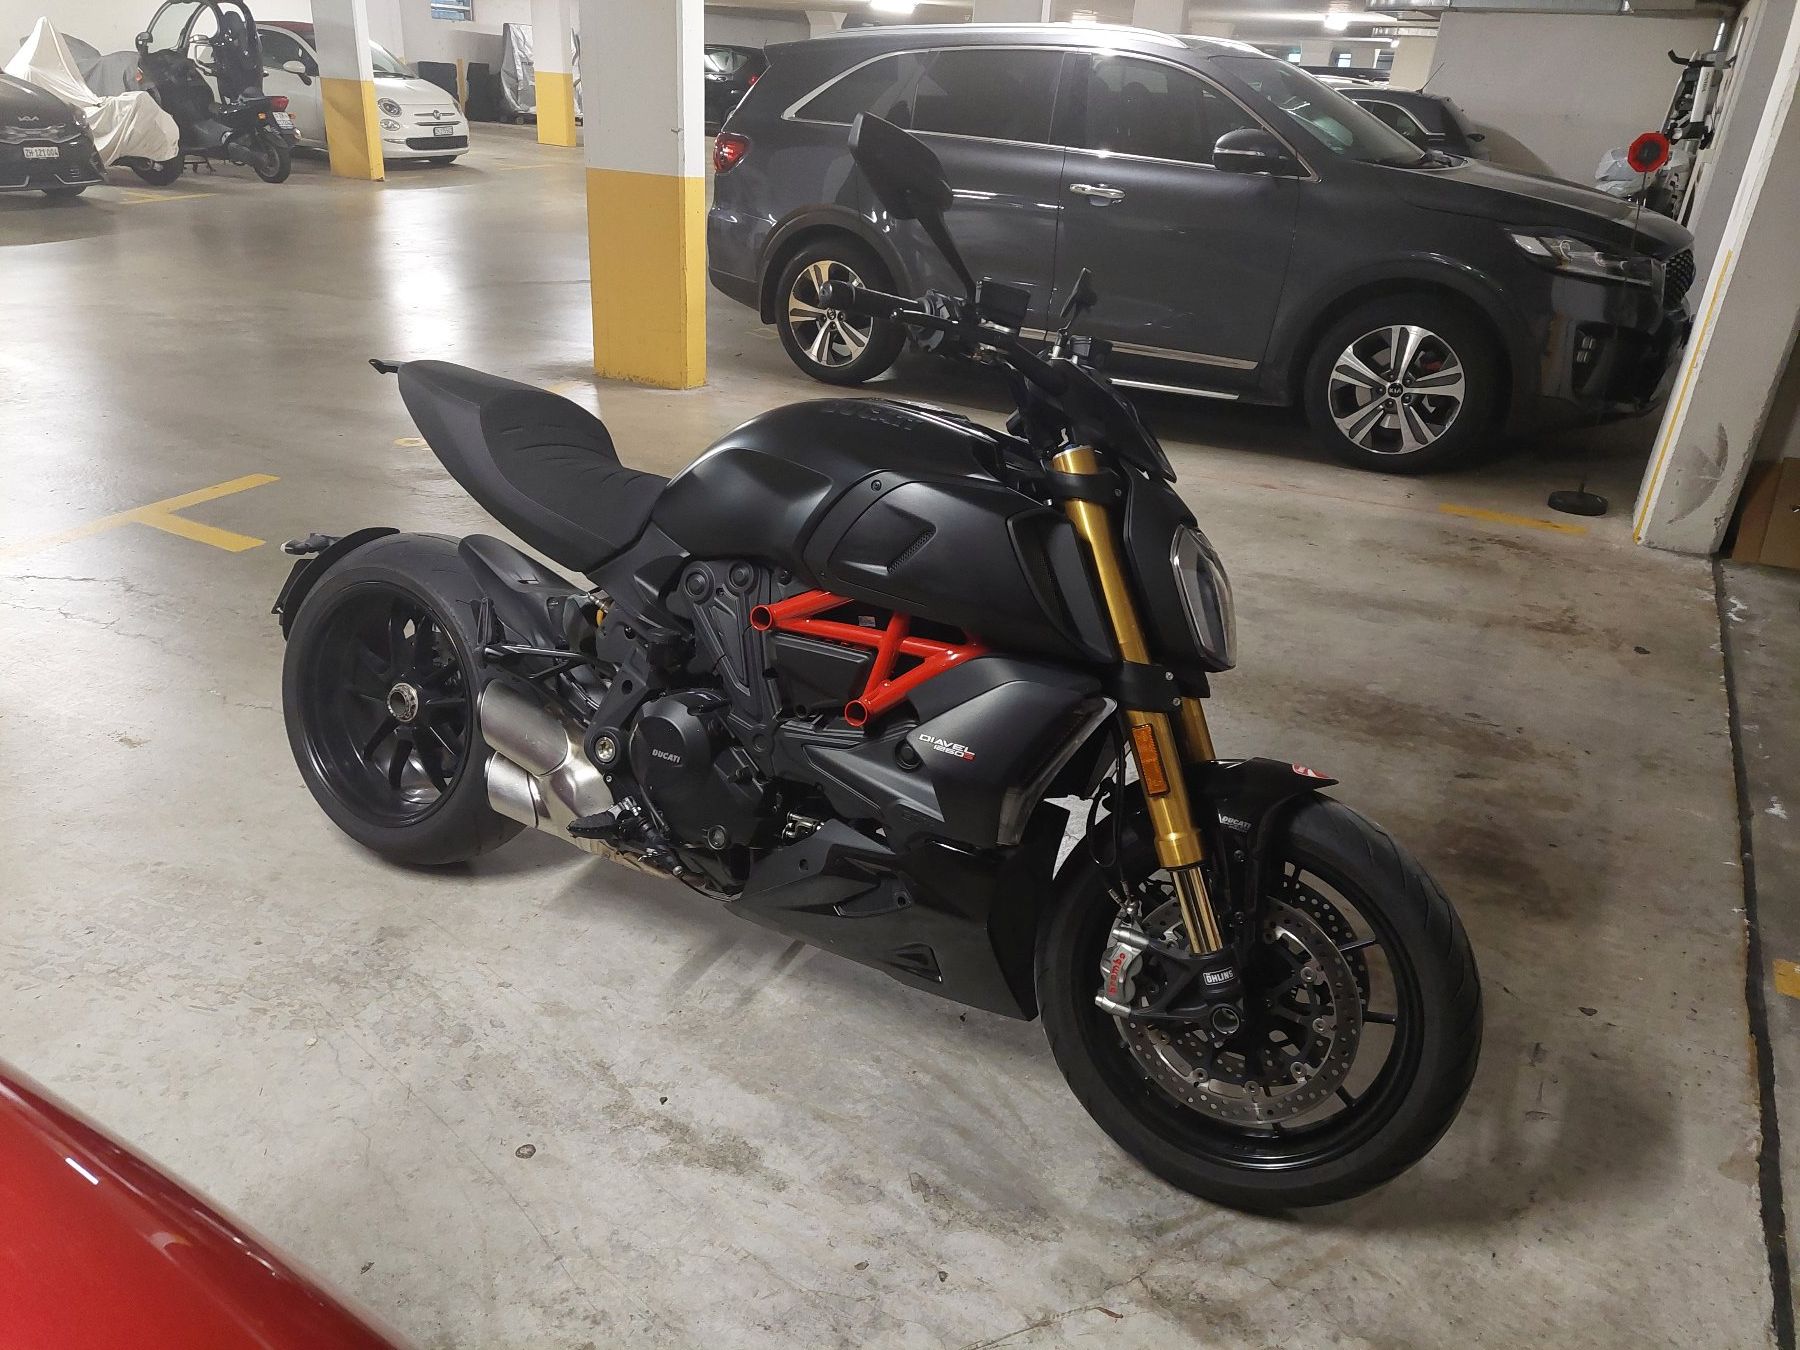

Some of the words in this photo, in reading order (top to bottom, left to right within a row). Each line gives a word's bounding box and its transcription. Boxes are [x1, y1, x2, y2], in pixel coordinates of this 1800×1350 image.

[919, 734, 976, 756] DIAVEL
[652, 748, 681, 763] DUCATI
[1221, 815, 1252, 830] DUCATI
[1108, 952, 1126, 996] brembo
